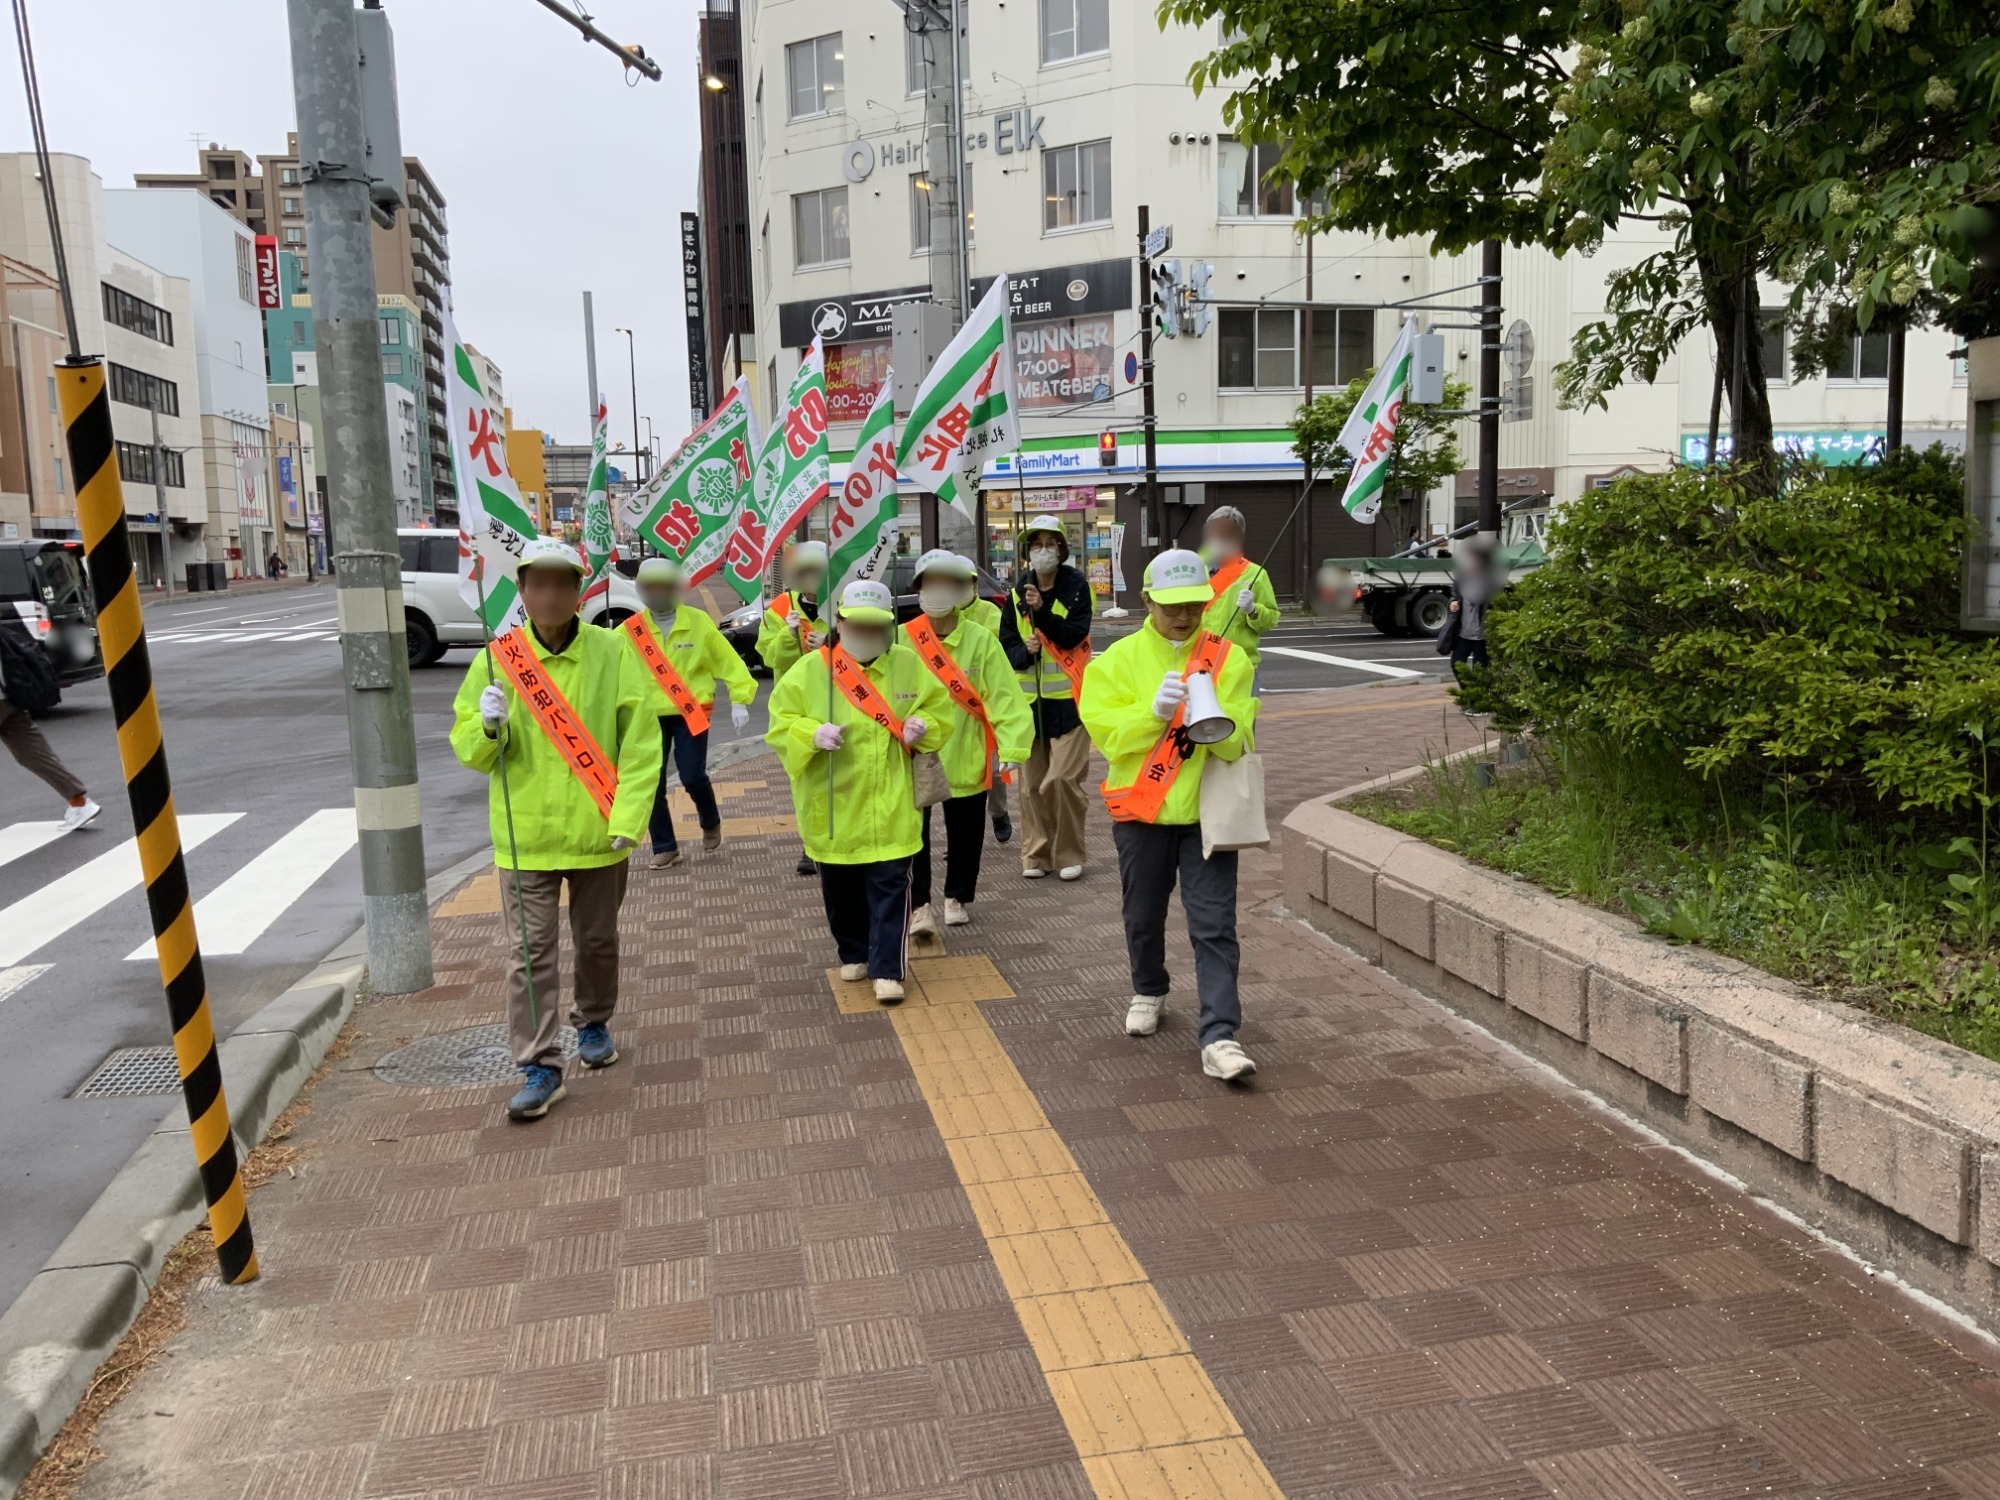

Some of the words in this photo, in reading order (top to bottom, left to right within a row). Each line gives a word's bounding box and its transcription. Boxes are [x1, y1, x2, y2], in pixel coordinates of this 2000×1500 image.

[881, 140, 921, 167] Hair
[995, 109, 1046, 156] Elk
[258, 249, 278, 305] TAIYO
[1009, 277, 1040, 290] EAT
[1013, 293, 1023, 303] &
[1025, 302, 1052, 314] BEER
[1016, 321, 1109, 355] DINNER
[1014, 454, 1080, 470] FamilyMart
